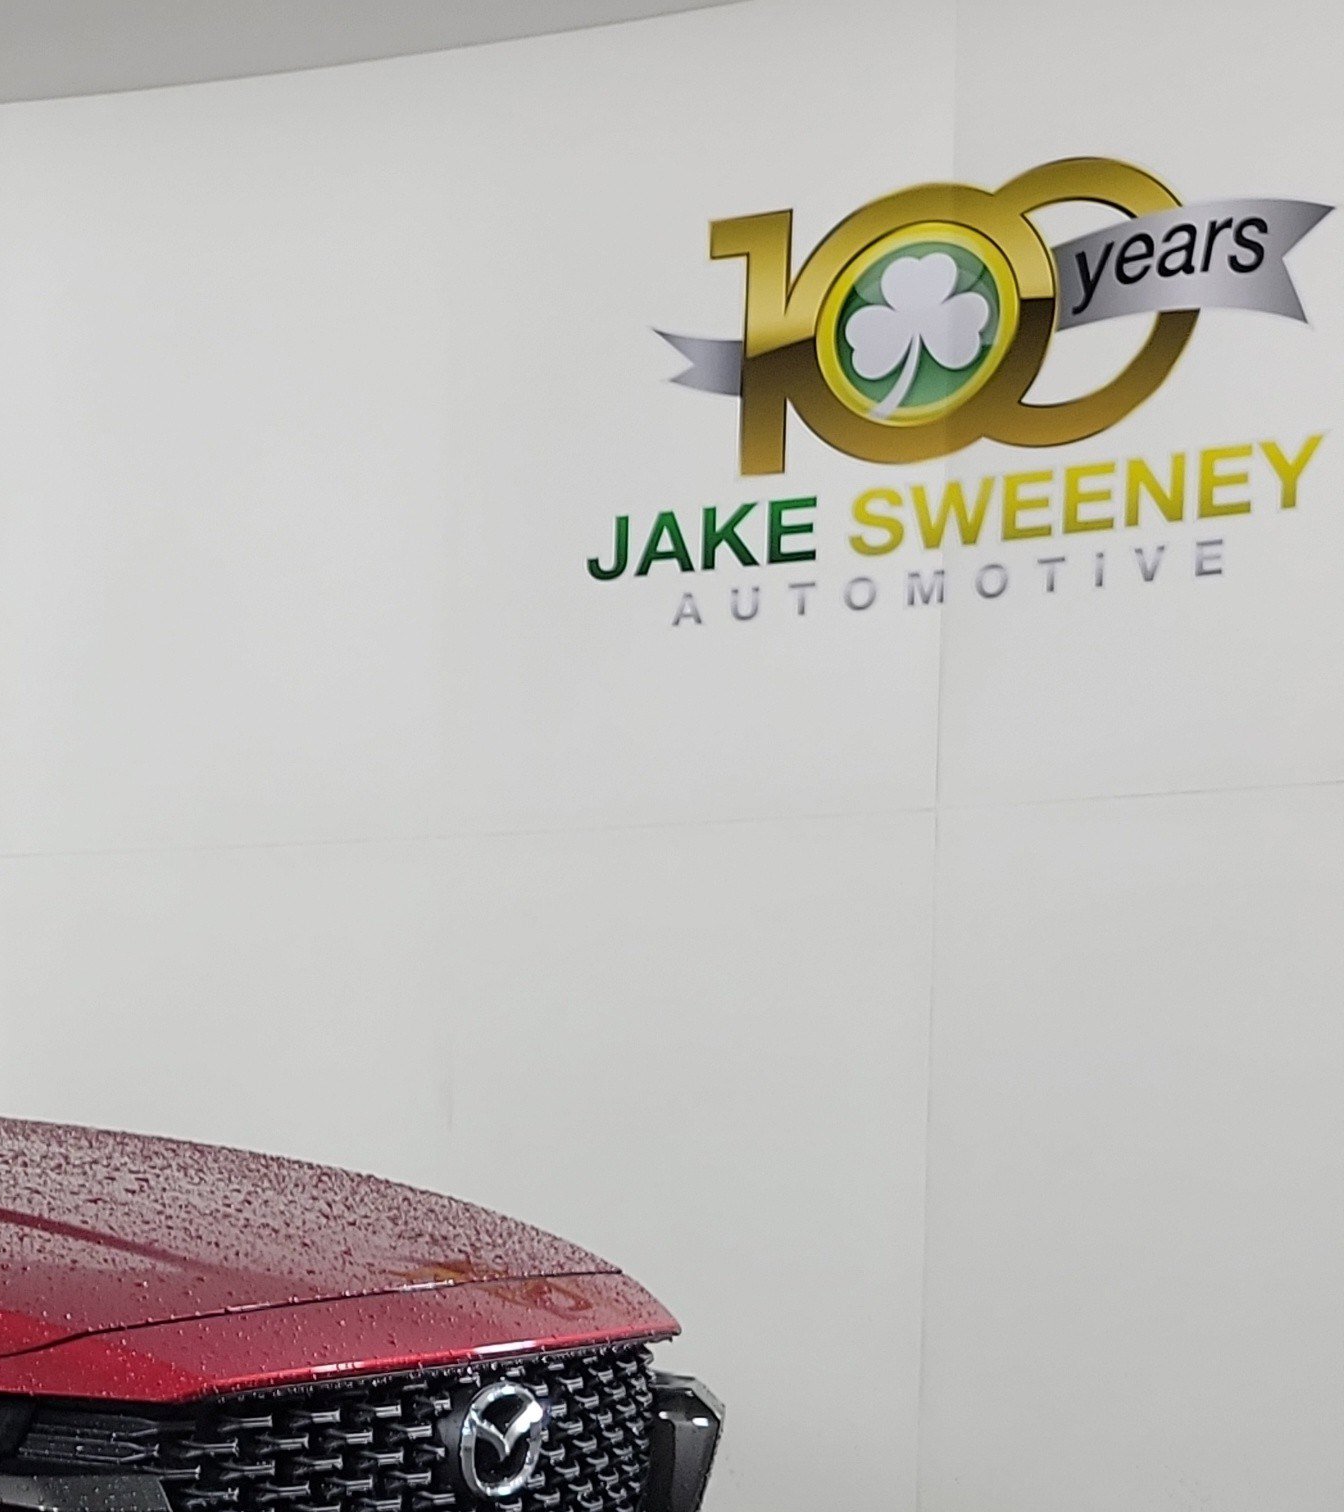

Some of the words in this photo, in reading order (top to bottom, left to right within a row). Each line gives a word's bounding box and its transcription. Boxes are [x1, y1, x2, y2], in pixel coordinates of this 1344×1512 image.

[709, 156, 1202, 477] 100
[1071, 214, 1269, 316] years
[586, 496, 819, 582] JAKE
[848, 432, 1325, 558] SWEENEY
[671, 540, 1225, 628] AUTOMOTIVE
